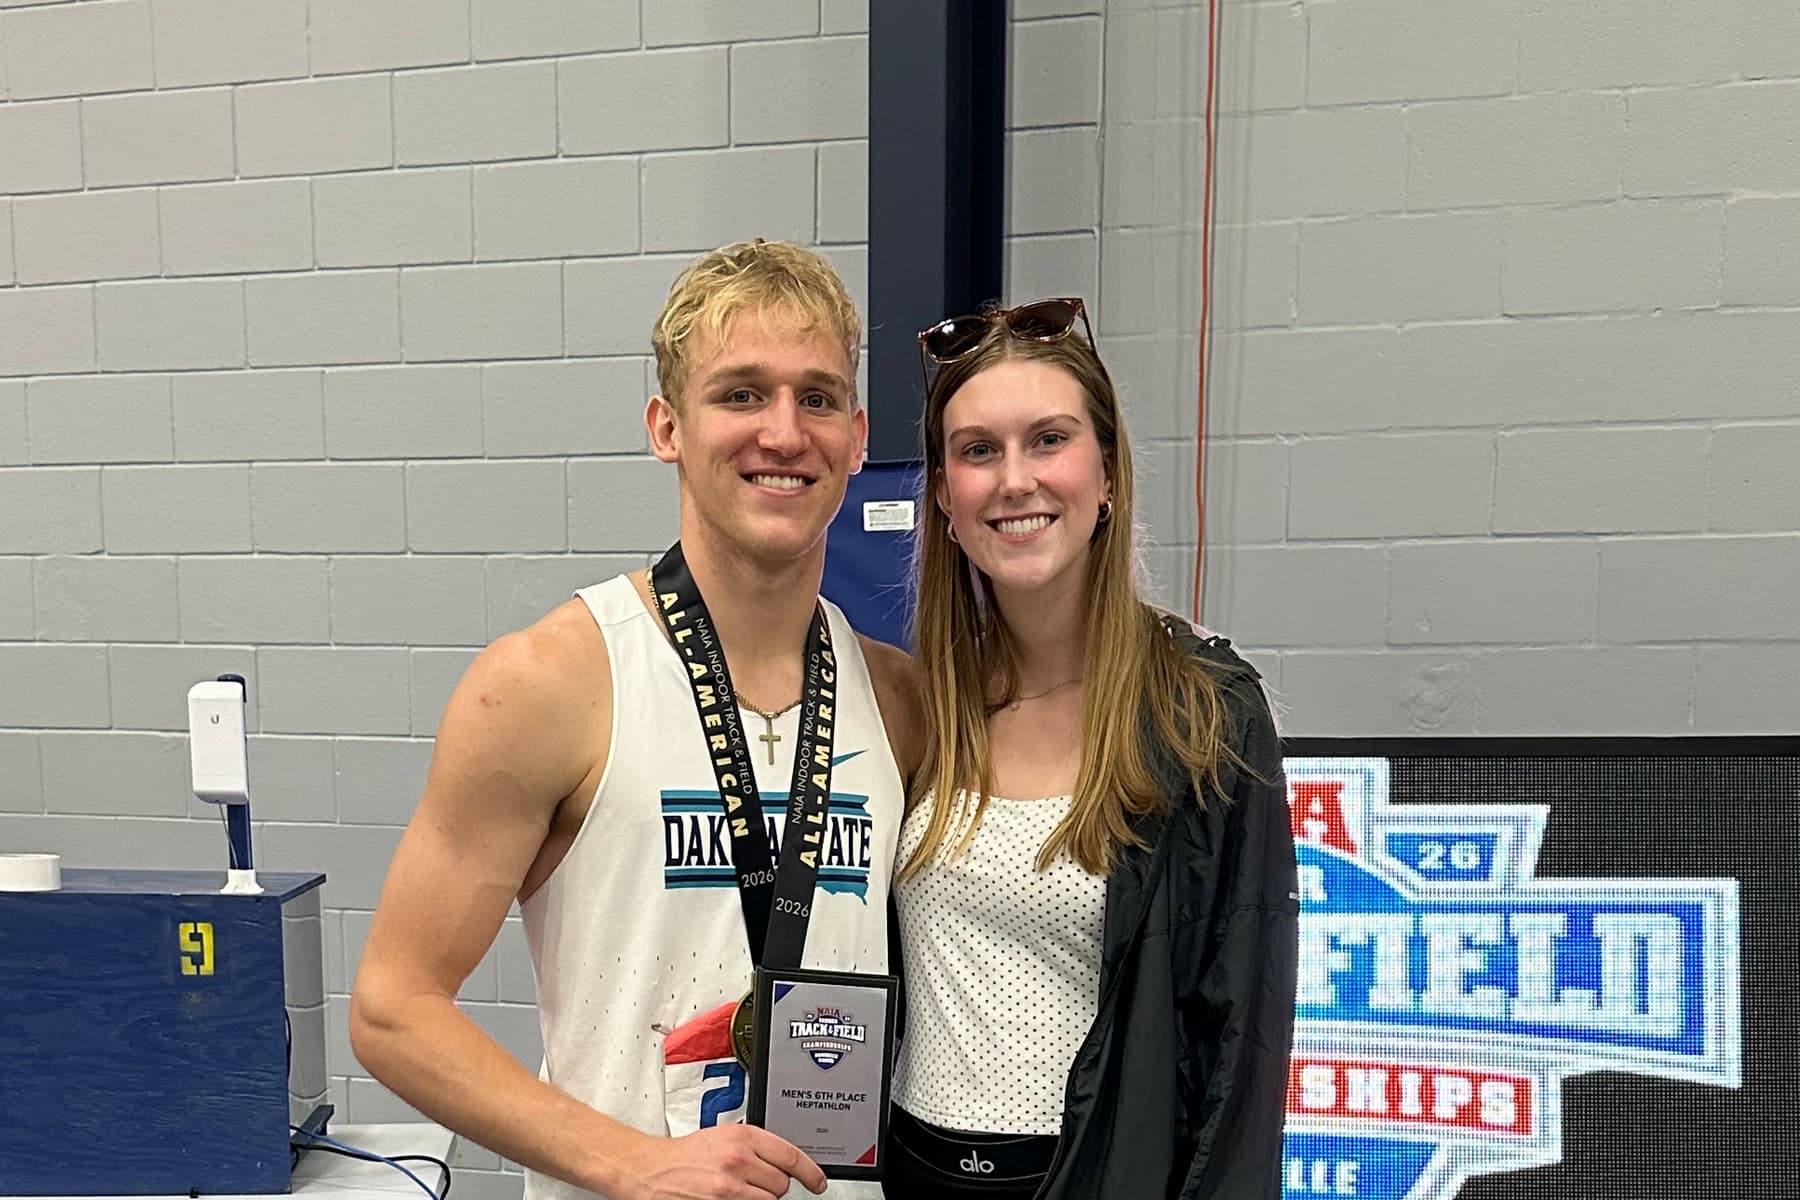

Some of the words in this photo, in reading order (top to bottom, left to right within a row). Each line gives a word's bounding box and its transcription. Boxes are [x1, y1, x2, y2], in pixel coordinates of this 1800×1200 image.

[811, 652, 821, 687] FIELD
[660, 592, 749, 838] ALL-AMERICAN
[694, 617, 712, 649] NAIA
[707, 649, 731, 704] INDOOR
[723, 705, 744, 748] TRACK
[737, 761, 754, 796] FIELD
[803, 701, 816, 736] TRACK
[796, 738, 813, 791] INDOOR
[792, 789, 806, 824] NAIA
[663, 815, 783, 868] DAKA
[1418, 841, 1481, 869] 26
[741, 869, 775, 888] 2026
[775, 897, 809, 918] 2026
[178, 922, 215, 976] 9
[1297, 911, 1685, 1038] FIELD
[781, 1089, 812, 1100] MEN'S
[814, 1091, 833, 1101] 6TH
[836, 1092, 867, 1103] PLACE
[796, 1100, 851, 1111] HEPTATHLON
[960, 1150, 994, 1173] alo
